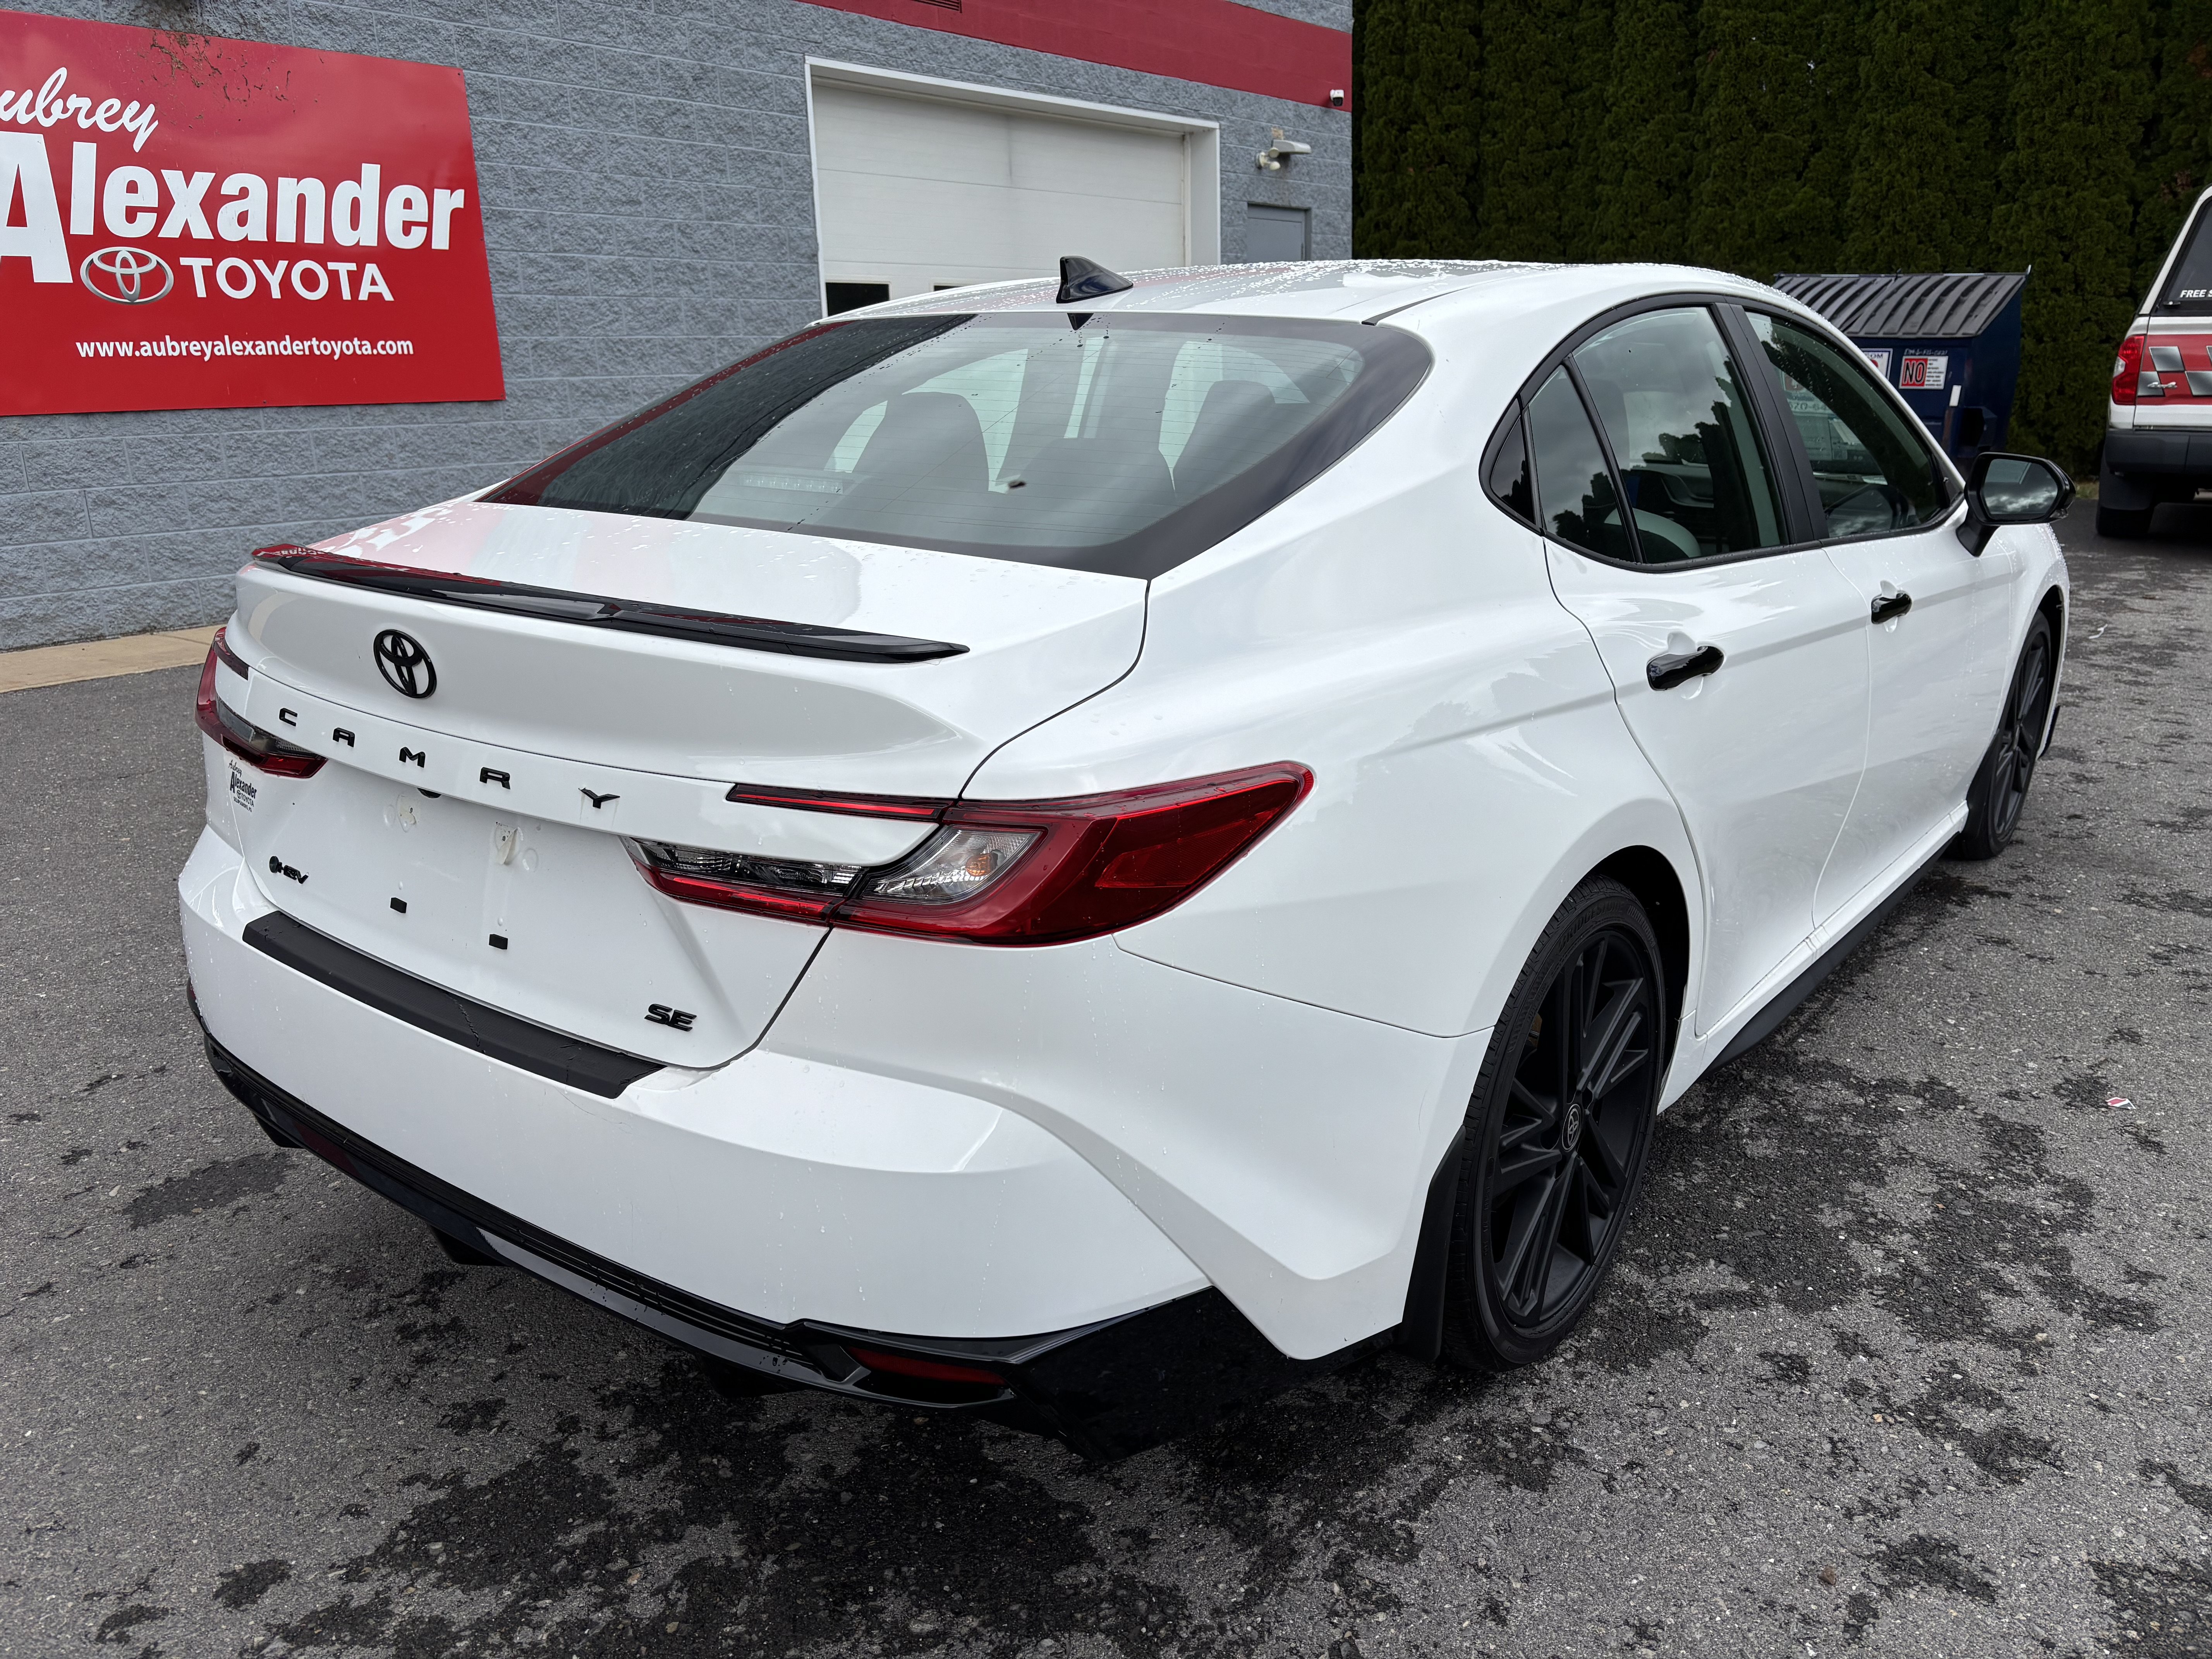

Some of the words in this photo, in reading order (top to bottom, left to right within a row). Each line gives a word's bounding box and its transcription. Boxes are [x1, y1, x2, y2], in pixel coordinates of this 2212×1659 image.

[0, 67, 158, 152] ubrey
[0, 131, 464, 283] Alexander
[180, 258, 394, 301] TOYOTA
[76, 335, 414, 362] www.aubreyalexandertoyota.com
[1903, 361, 1925, 385] NO
[278, 707, 620, 809] CAMRY
[230, 771, 257, 799] Alexander
[241, 793, 254, 807] TOYOTA
[277, 862, 309, 884] HEV
[644, 1004, 697, 1032] SE
